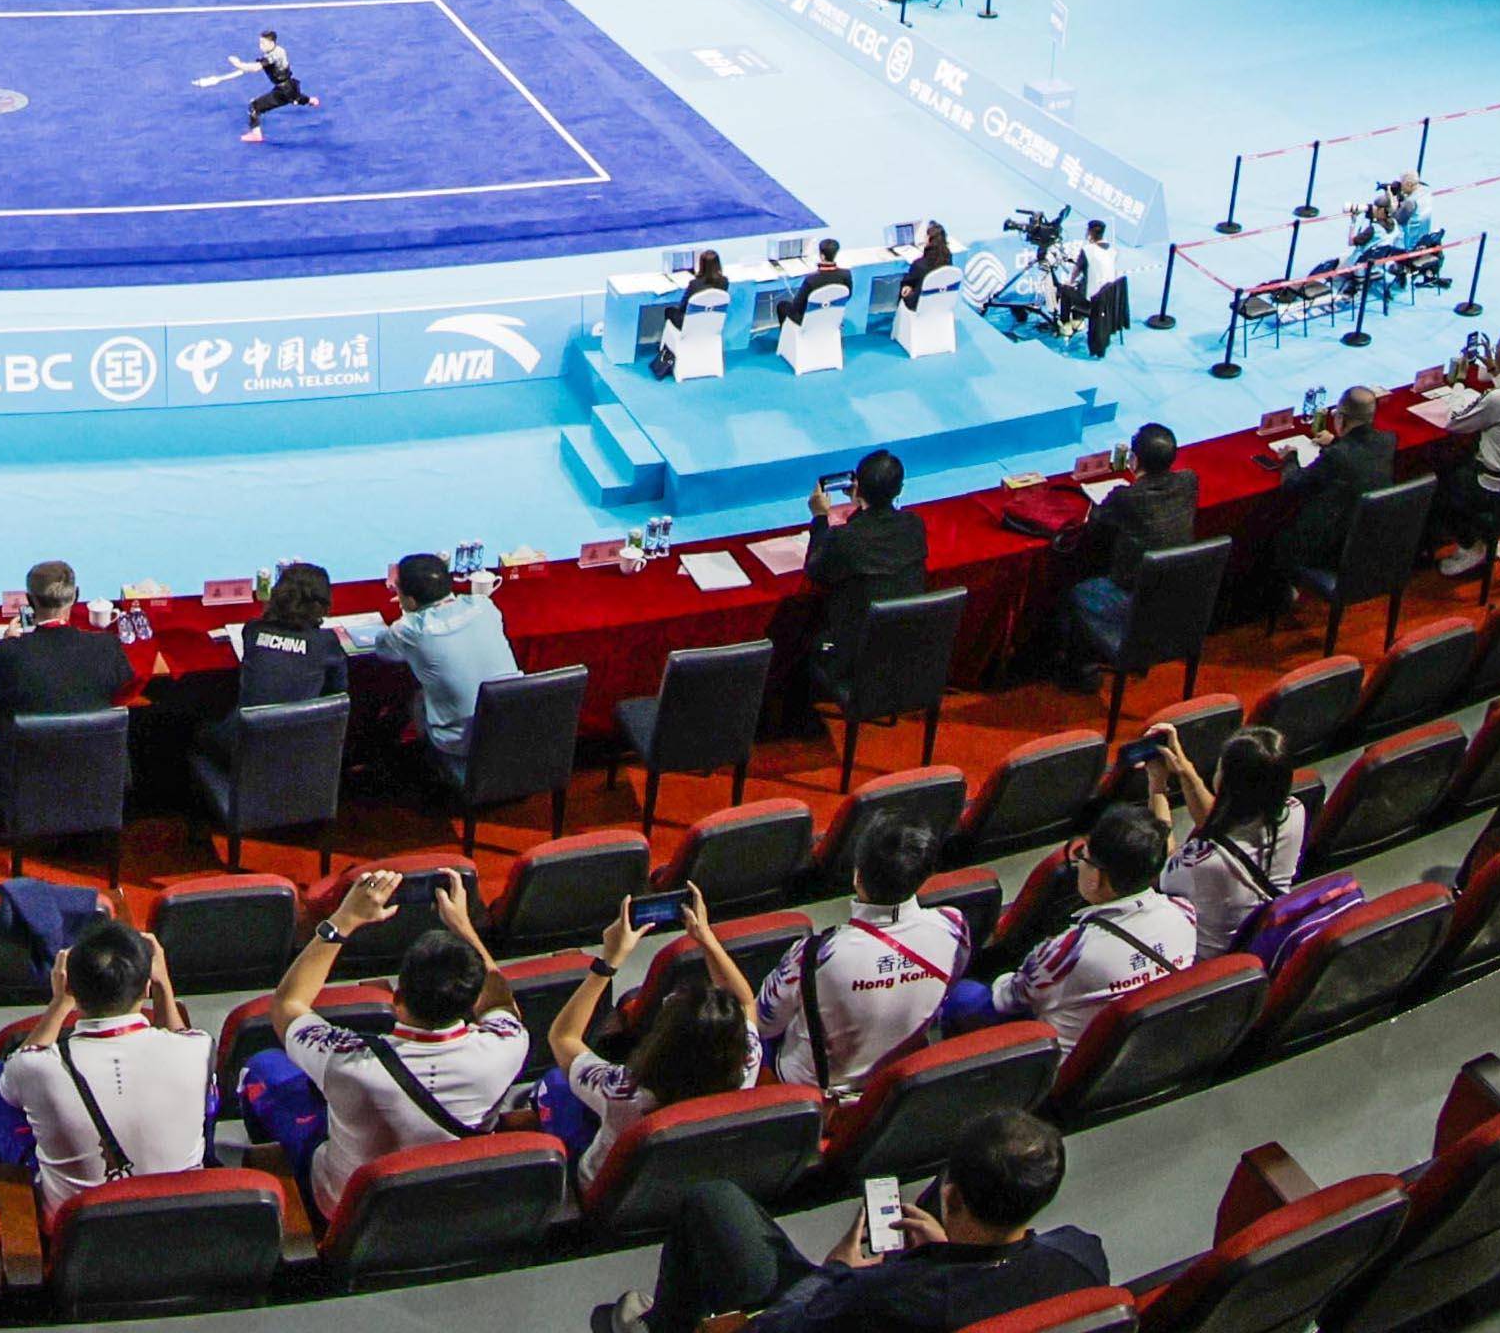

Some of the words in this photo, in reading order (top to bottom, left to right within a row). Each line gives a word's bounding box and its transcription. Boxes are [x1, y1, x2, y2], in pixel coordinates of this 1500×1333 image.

[847, 18, 889, 62] ICBC
[934, 58, 969, 97] PICC
[242, 333, 370, 377] 中国电信
[423, 349, 494, 385] ANTA
[243, 377, 294, 392] CHINA
[297, 371, 371, 388] TELECOM
[851, 976, 895, 991] Hong
[1109, 973, 1151, 993] Hong
